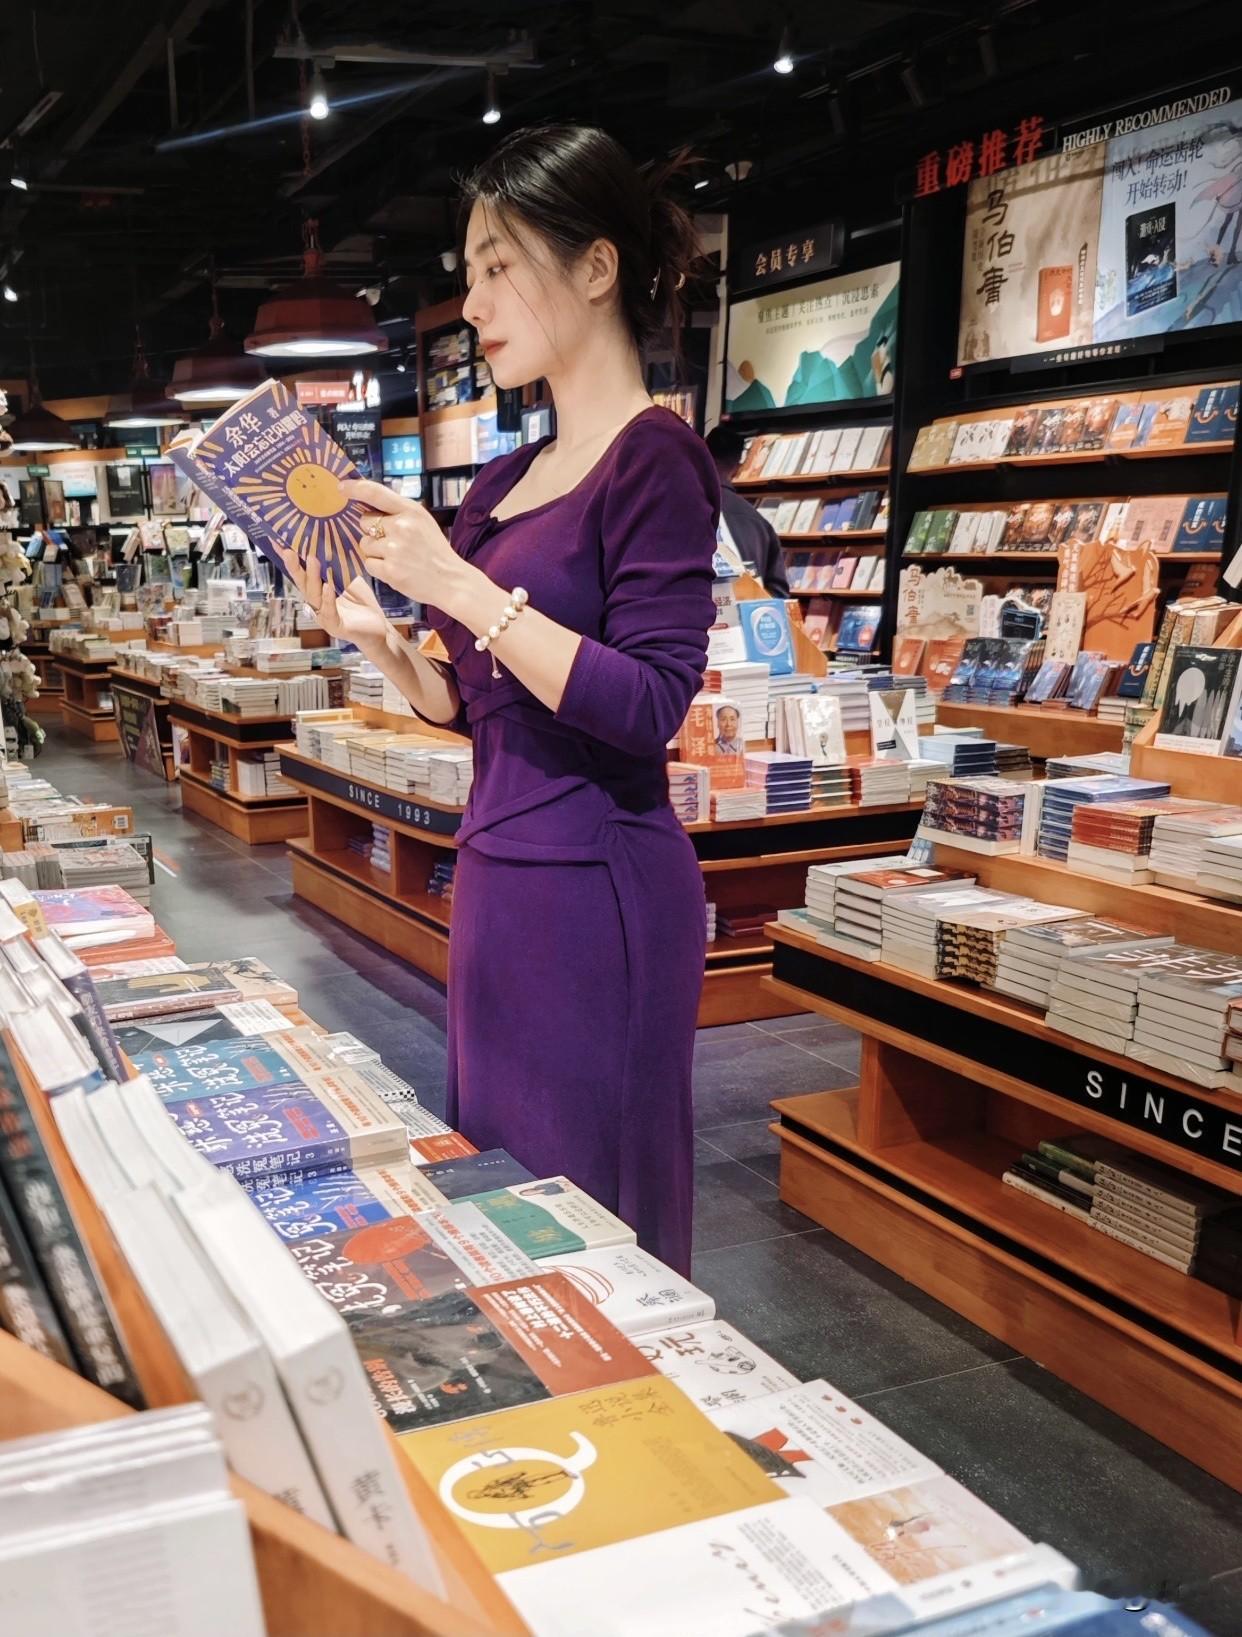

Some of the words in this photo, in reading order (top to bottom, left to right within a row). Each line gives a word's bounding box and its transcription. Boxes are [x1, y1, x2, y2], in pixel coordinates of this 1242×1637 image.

[1062, 123, 1112, 154] HIGHLY
[1114, 86, 1232, 138] RECOMMENDED
[913, 115, 1045, 198] 重磅推荐
[754, 239, 816, 277] 会员专享
[224, 412, 263, 449] 余华
[348, 784, 381, 809] SINCE
[397, 803, 432, 826] 1993
[209, 1091, 289, 1150] 洗冤笔记
[1085, 1070, 1242, 1157] SINCE
